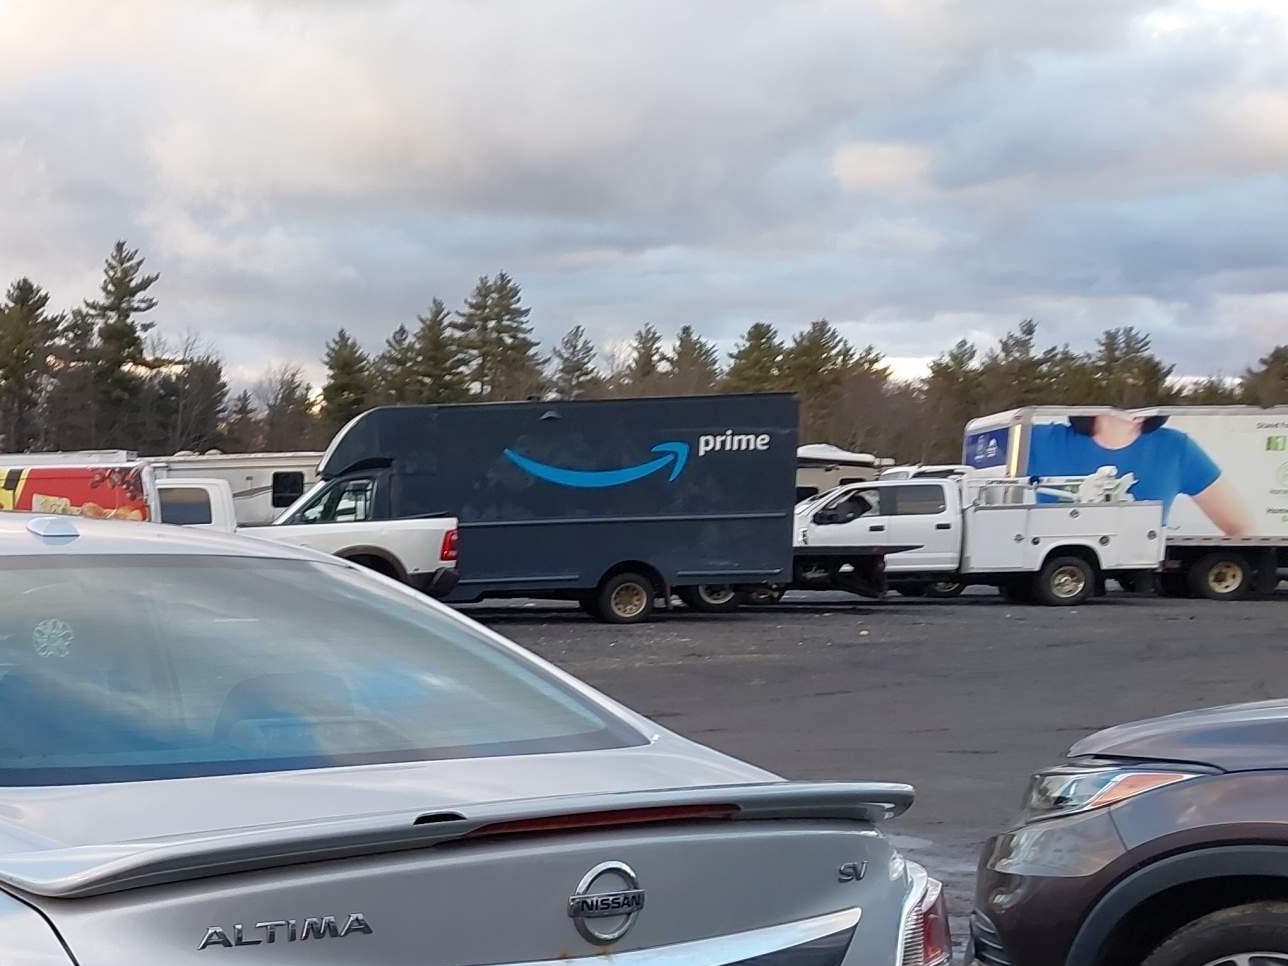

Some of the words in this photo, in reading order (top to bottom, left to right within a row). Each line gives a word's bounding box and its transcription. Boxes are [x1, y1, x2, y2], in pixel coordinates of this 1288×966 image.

[698, 429, 771, 457] prime
[838, 860, 869, 884] SV
[580, 894, 642, 912] NISSAN
[197, 912, 373, 951] ALTIMA
